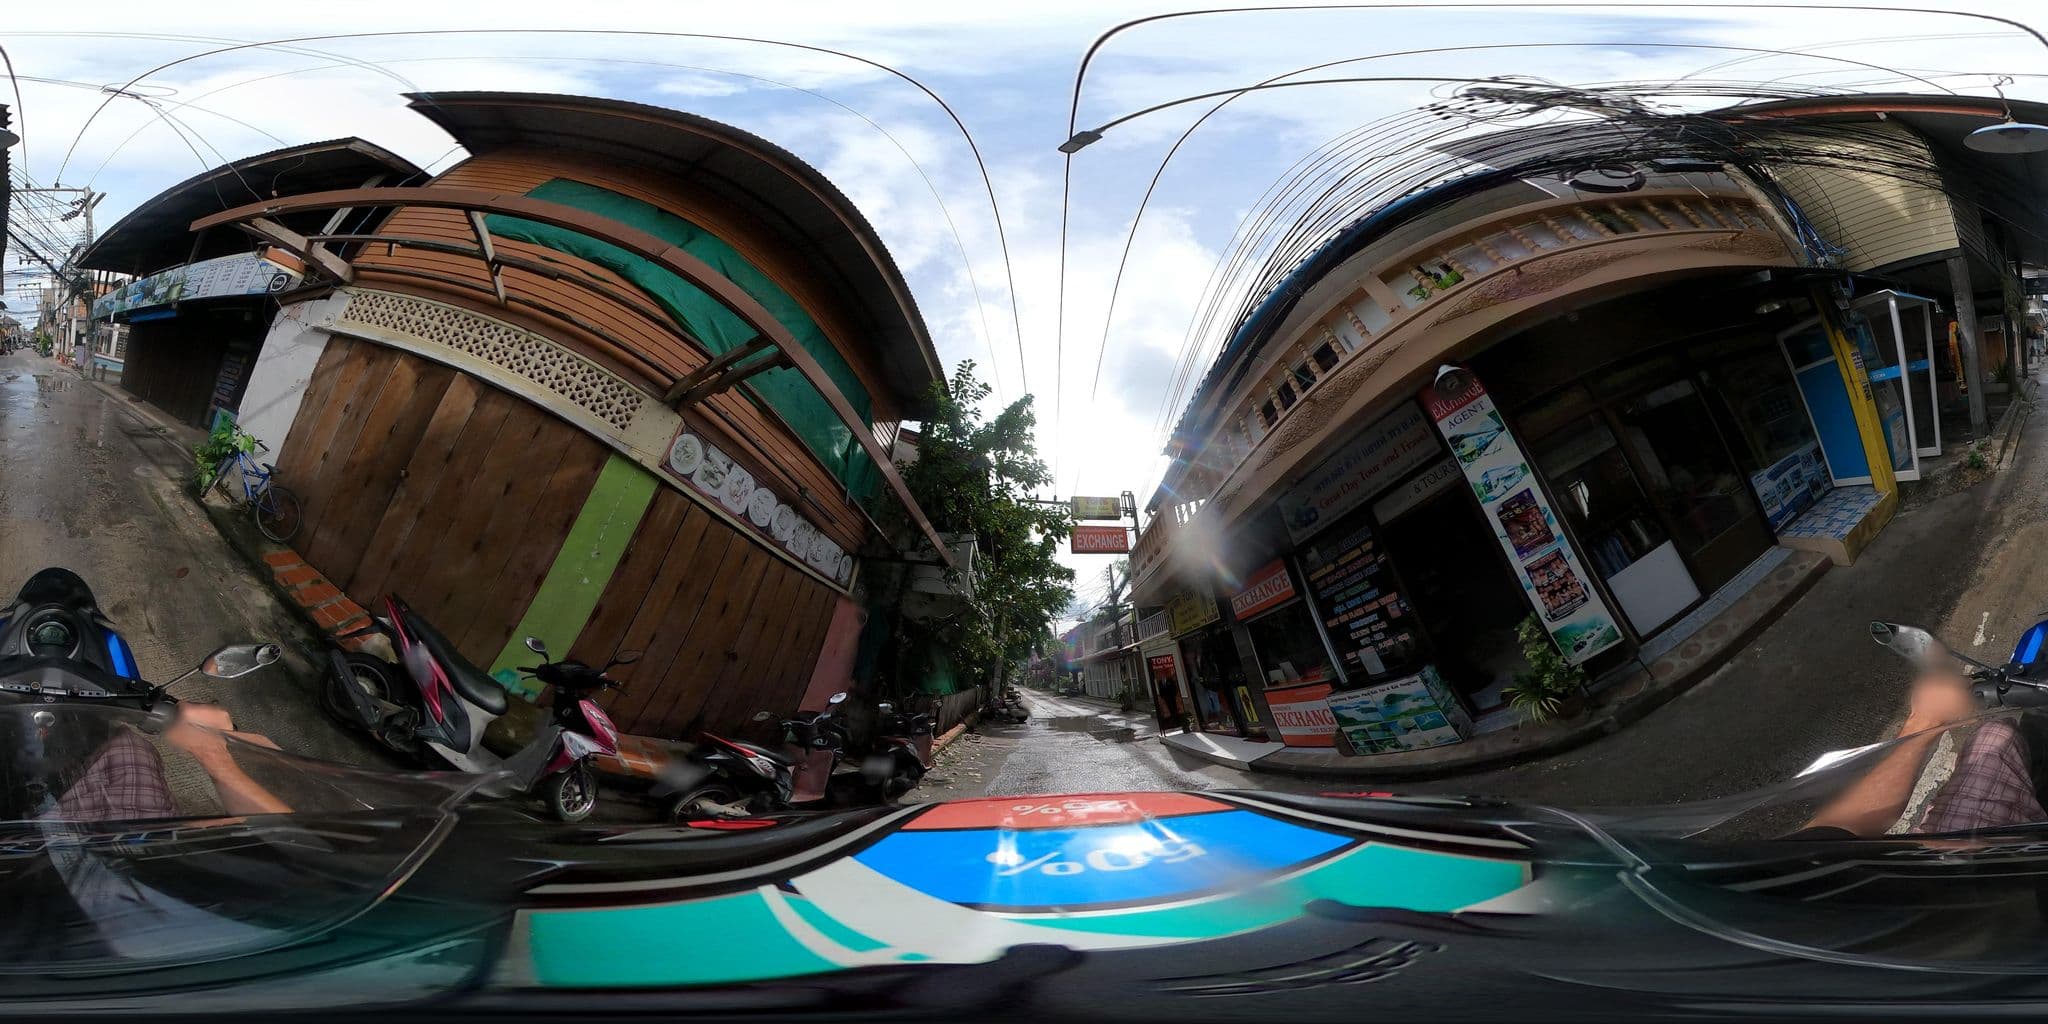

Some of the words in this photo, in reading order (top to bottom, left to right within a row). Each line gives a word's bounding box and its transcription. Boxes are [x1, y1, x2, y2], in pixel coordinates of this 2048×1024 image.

[1448, 400, 1485, 430] AGENT
[1359, 464, 1381, 482] Tour
[1383, 448, 1400, 467] and
[1421, 460, 1457, 488] TOURS
[1076, 534, 1125, 549] EXCHANGE
[1234, 572, 1290, 611] EXCHANGE
[1274, 708, 1335, 727] EXCHANG
